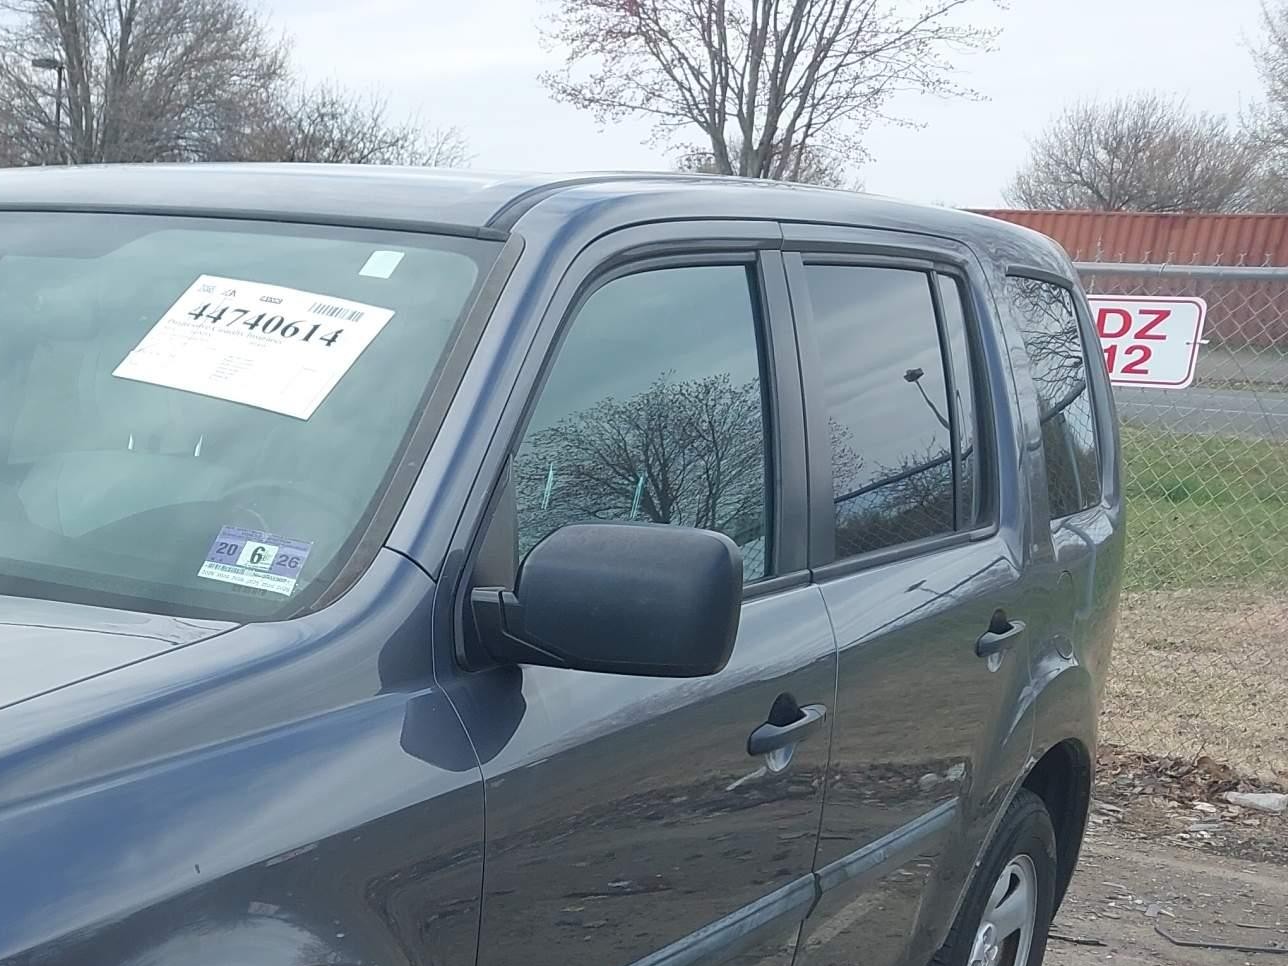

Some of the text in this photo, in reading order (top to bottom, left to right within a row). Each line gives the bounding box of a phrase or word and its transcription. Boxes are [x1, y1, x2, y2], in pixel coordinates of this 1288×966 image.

[187, 302, 344, 347] 44740614
[1096, 308, 1172, 340] DZ
[1103, 344, 1152, 375] 12
[216, 542, 300, 569] 20 6 26
